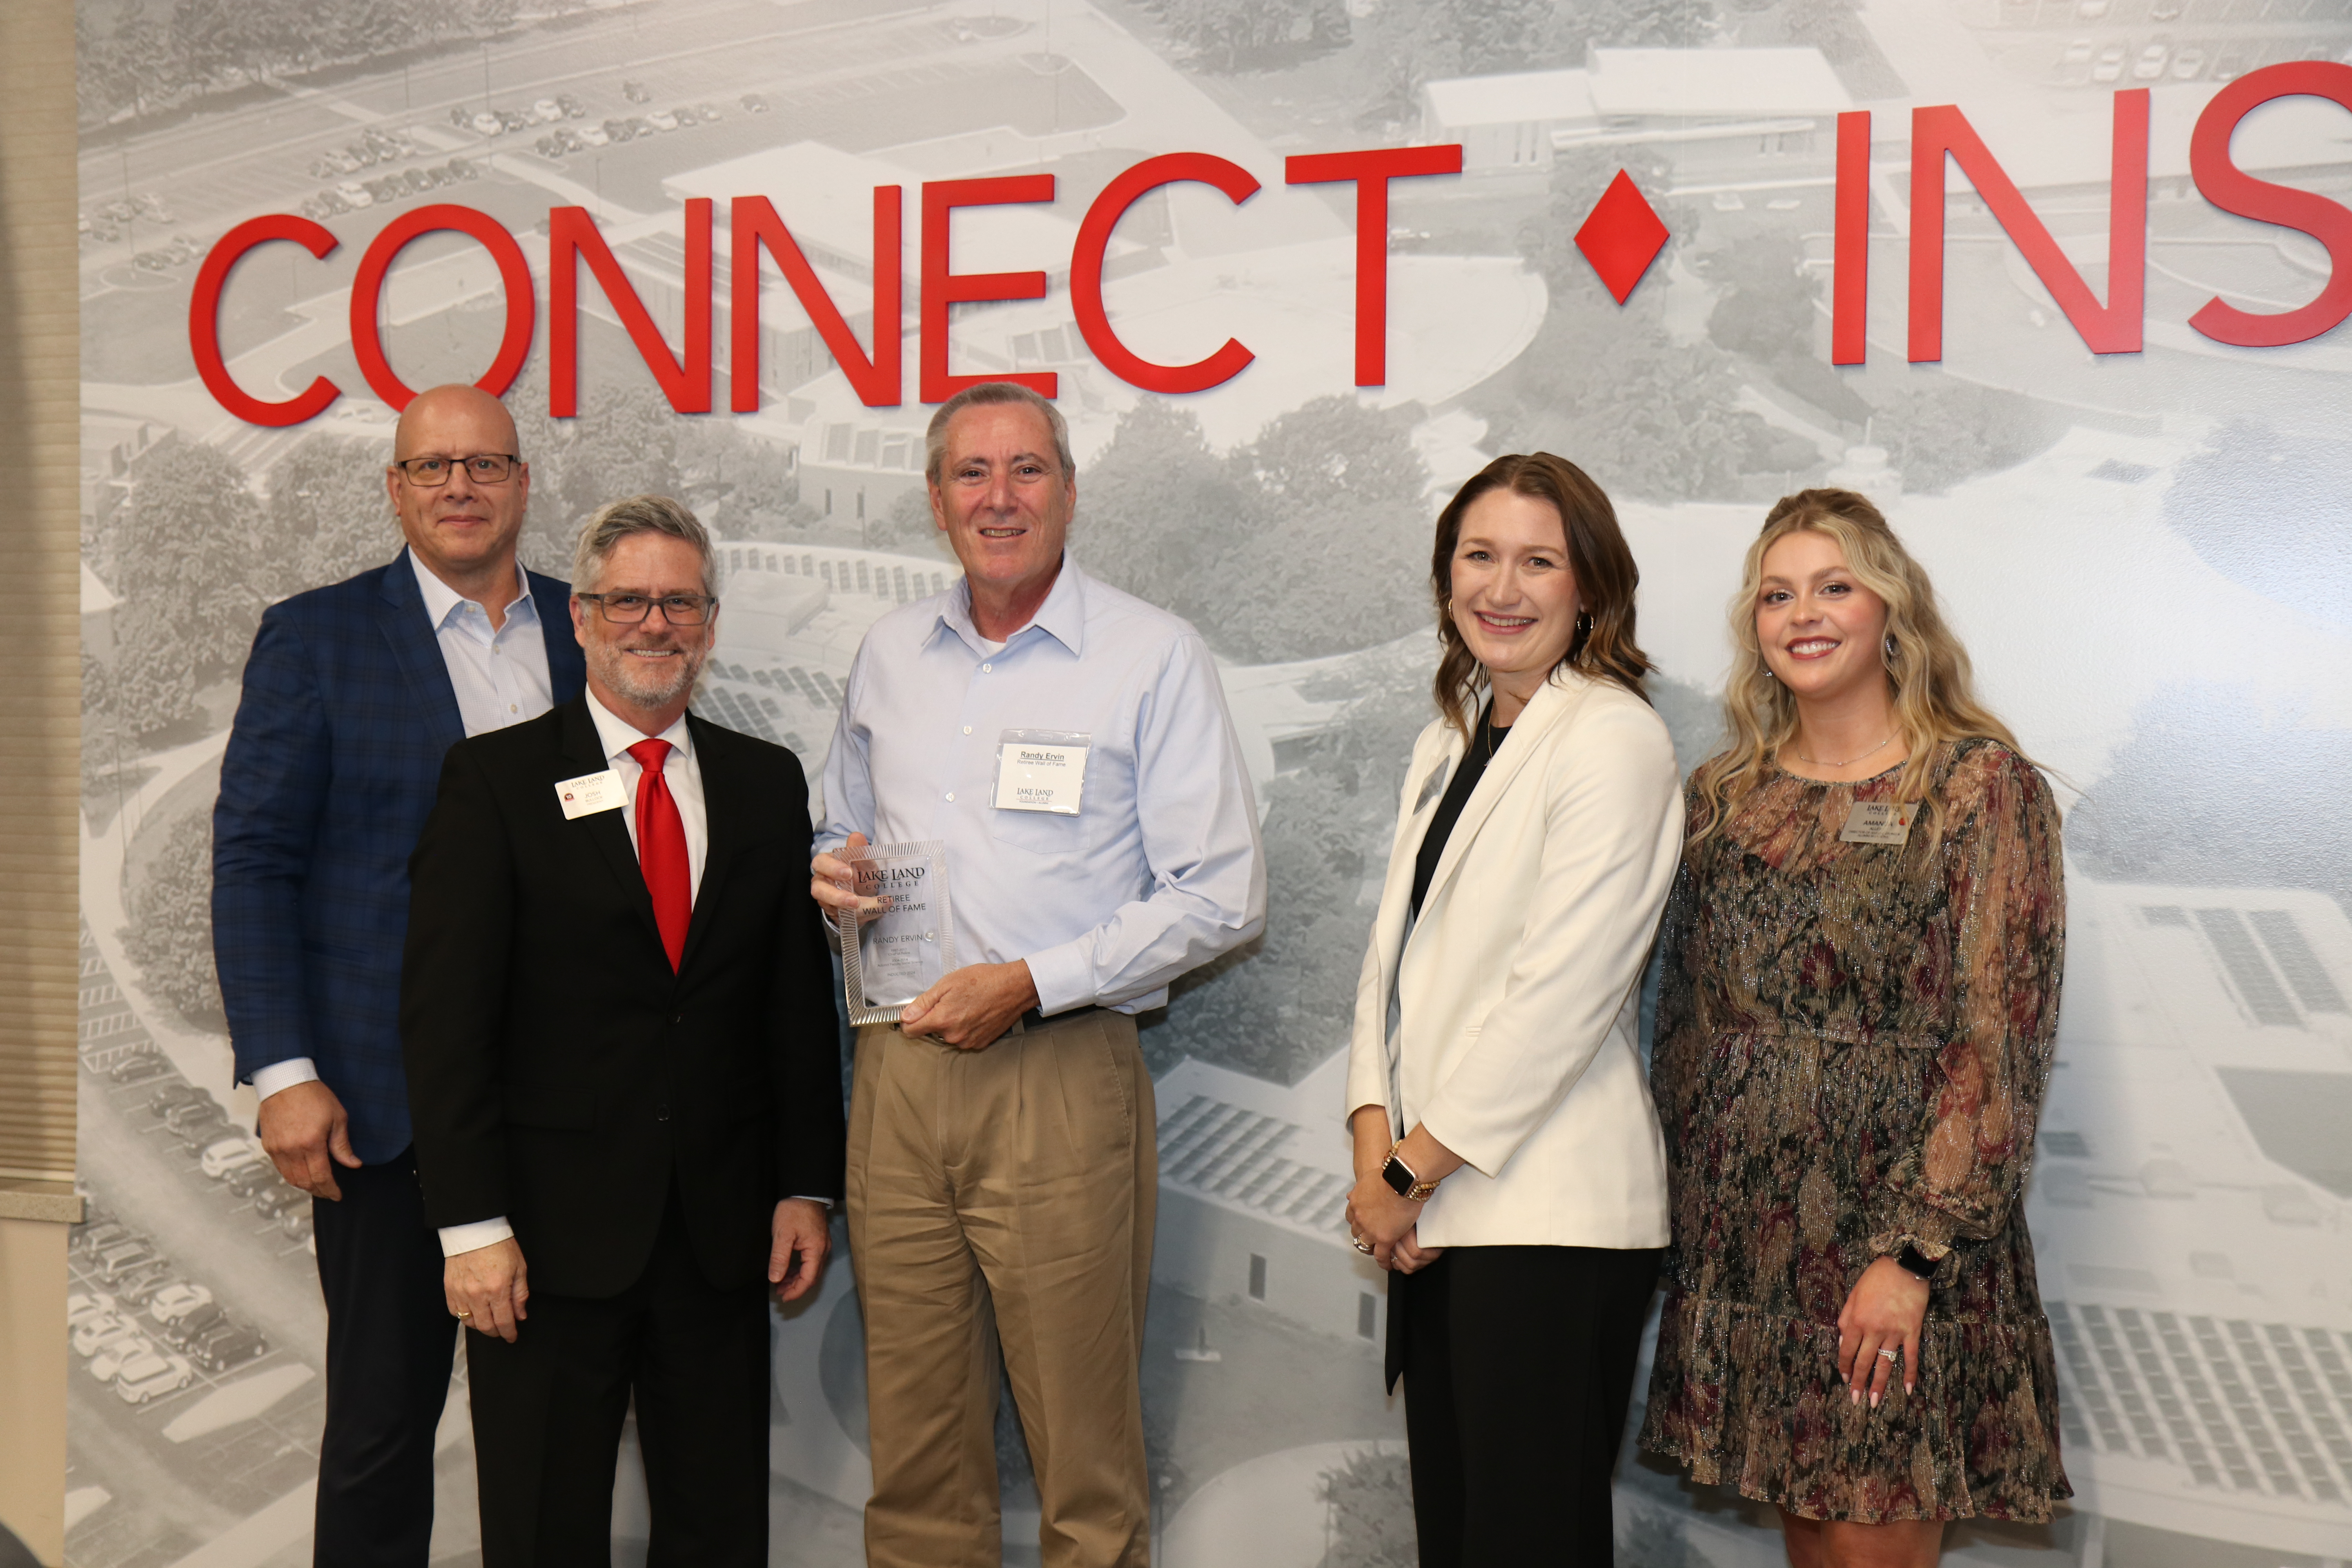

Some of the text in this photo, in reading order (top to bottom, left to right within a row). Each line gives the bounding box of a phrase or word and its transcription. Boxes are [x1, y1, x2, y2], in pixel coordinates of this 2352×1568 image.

[190, 60, 2352, 426] CONNECT INS
[571, 775, 604, 788] LAKE LAND
[576, 781, 603, 790] COLLEGE
[585, 790, 601, 799] JOSH
[1017, 788, 1053, 797] LAKE LAND
[858, 867, 925, 883] LAKE LAND
[866, 880, 918, 890] COLLEGE
[877, 894, 911, 904] RETIREE
[903, 903, 926, 912] FAME
